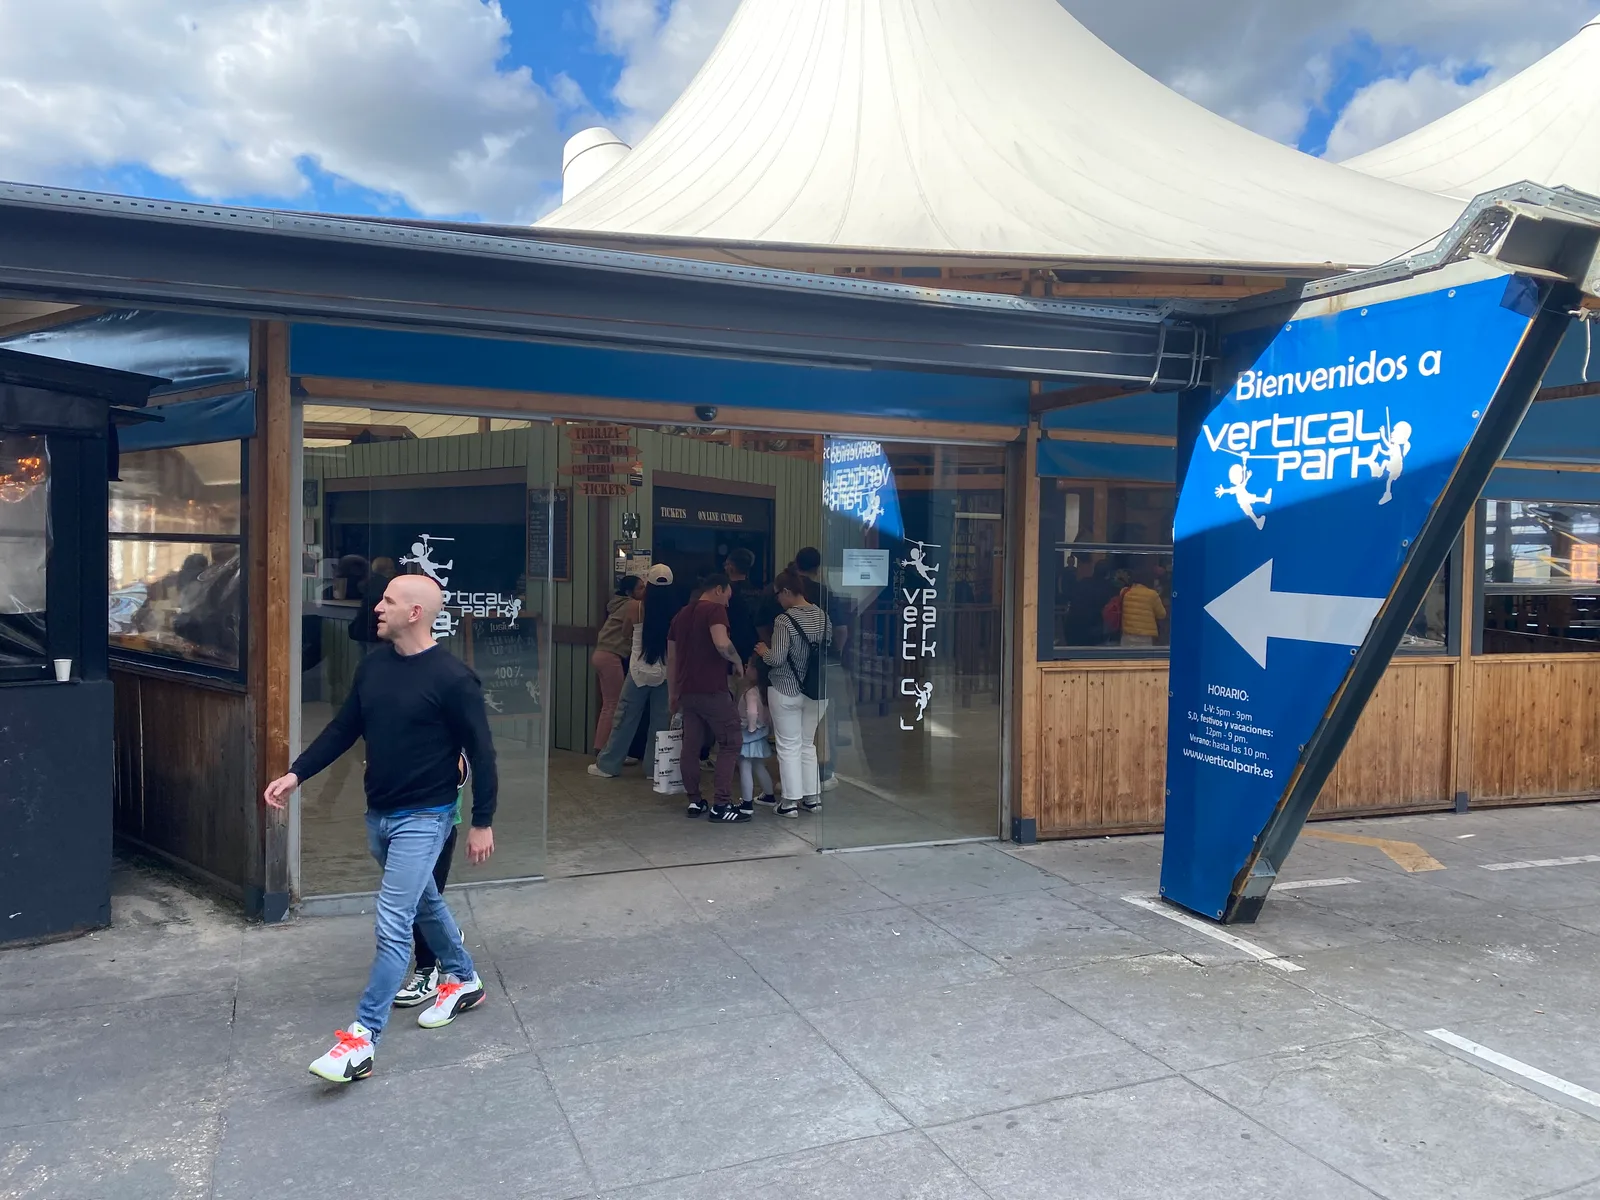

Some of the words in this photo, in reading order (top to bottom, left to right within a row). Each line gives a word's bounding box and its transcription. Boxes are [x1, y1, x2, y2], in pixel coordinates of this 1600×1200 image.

[1235, 349, 1408, 401] Bienvenidos
[1417, 349, 1442, 377] a
[576, 426, 620, 440] TERRAZA
[581, 443, 629, 456] ENTRADA
[584, 483, 627, 496] TICKETS
[660, 506, 687, 519] TICKETS
[1207, 684, 1250, 702] HORARIO:
[1235, 710, 1253, 722] 9pm
[1200, 713, 1223, 727] festivos
[1223, 720, 1229, 730] y
[1229, 722, 1274, 738] vacaciones:
[1205, 726, 1222, 738] 12pm
[1189, 732, 1212, 747] Verano:
[1212, 739, 1230, 752] hasta
[1231, 743, 1242, 754] las
[1243, 746, 1254, 757] 10
[1182, 748, 1274, 779] www.verticalpark.es
